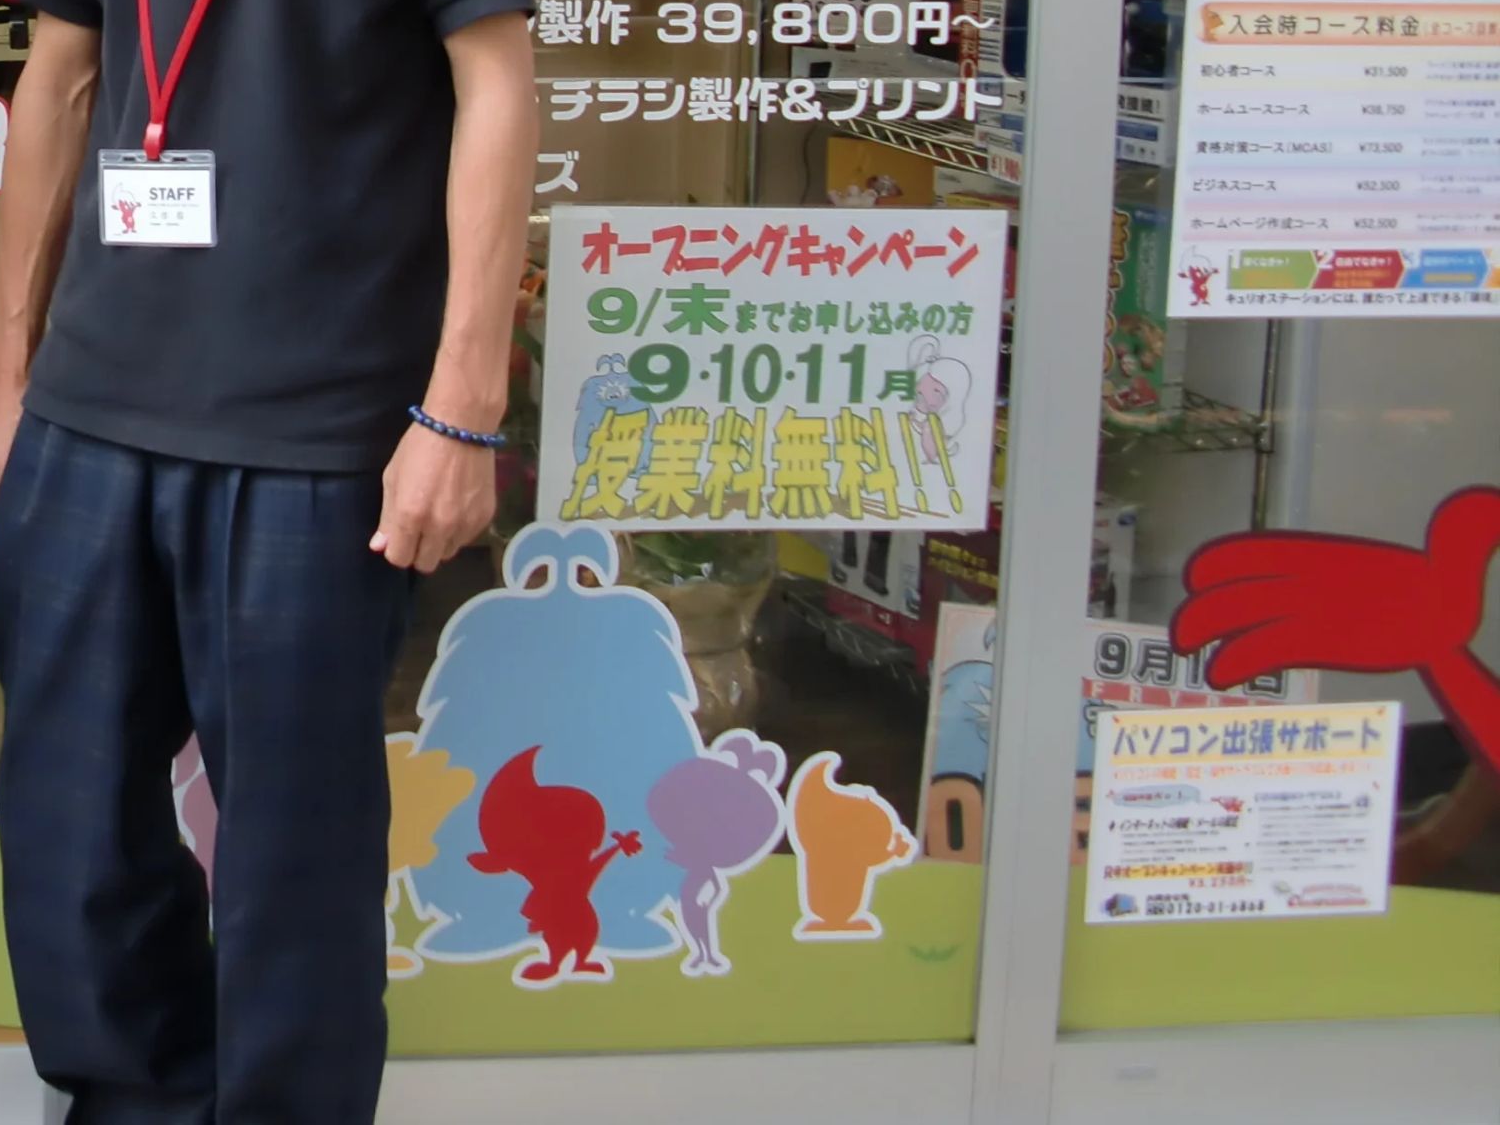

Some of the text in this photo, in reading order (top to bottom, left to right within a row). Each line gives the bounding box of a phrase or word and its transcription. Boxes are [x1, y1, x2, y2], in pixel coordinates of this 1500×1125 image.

[1227, 14, 1421, 38] 入会時コース料金
[149, 187, 196, 201] STAFF
[581, 221, 980, 277] オープニングキャンペーン
[1112, 718, 1381, 756] パソコン出張サポート
